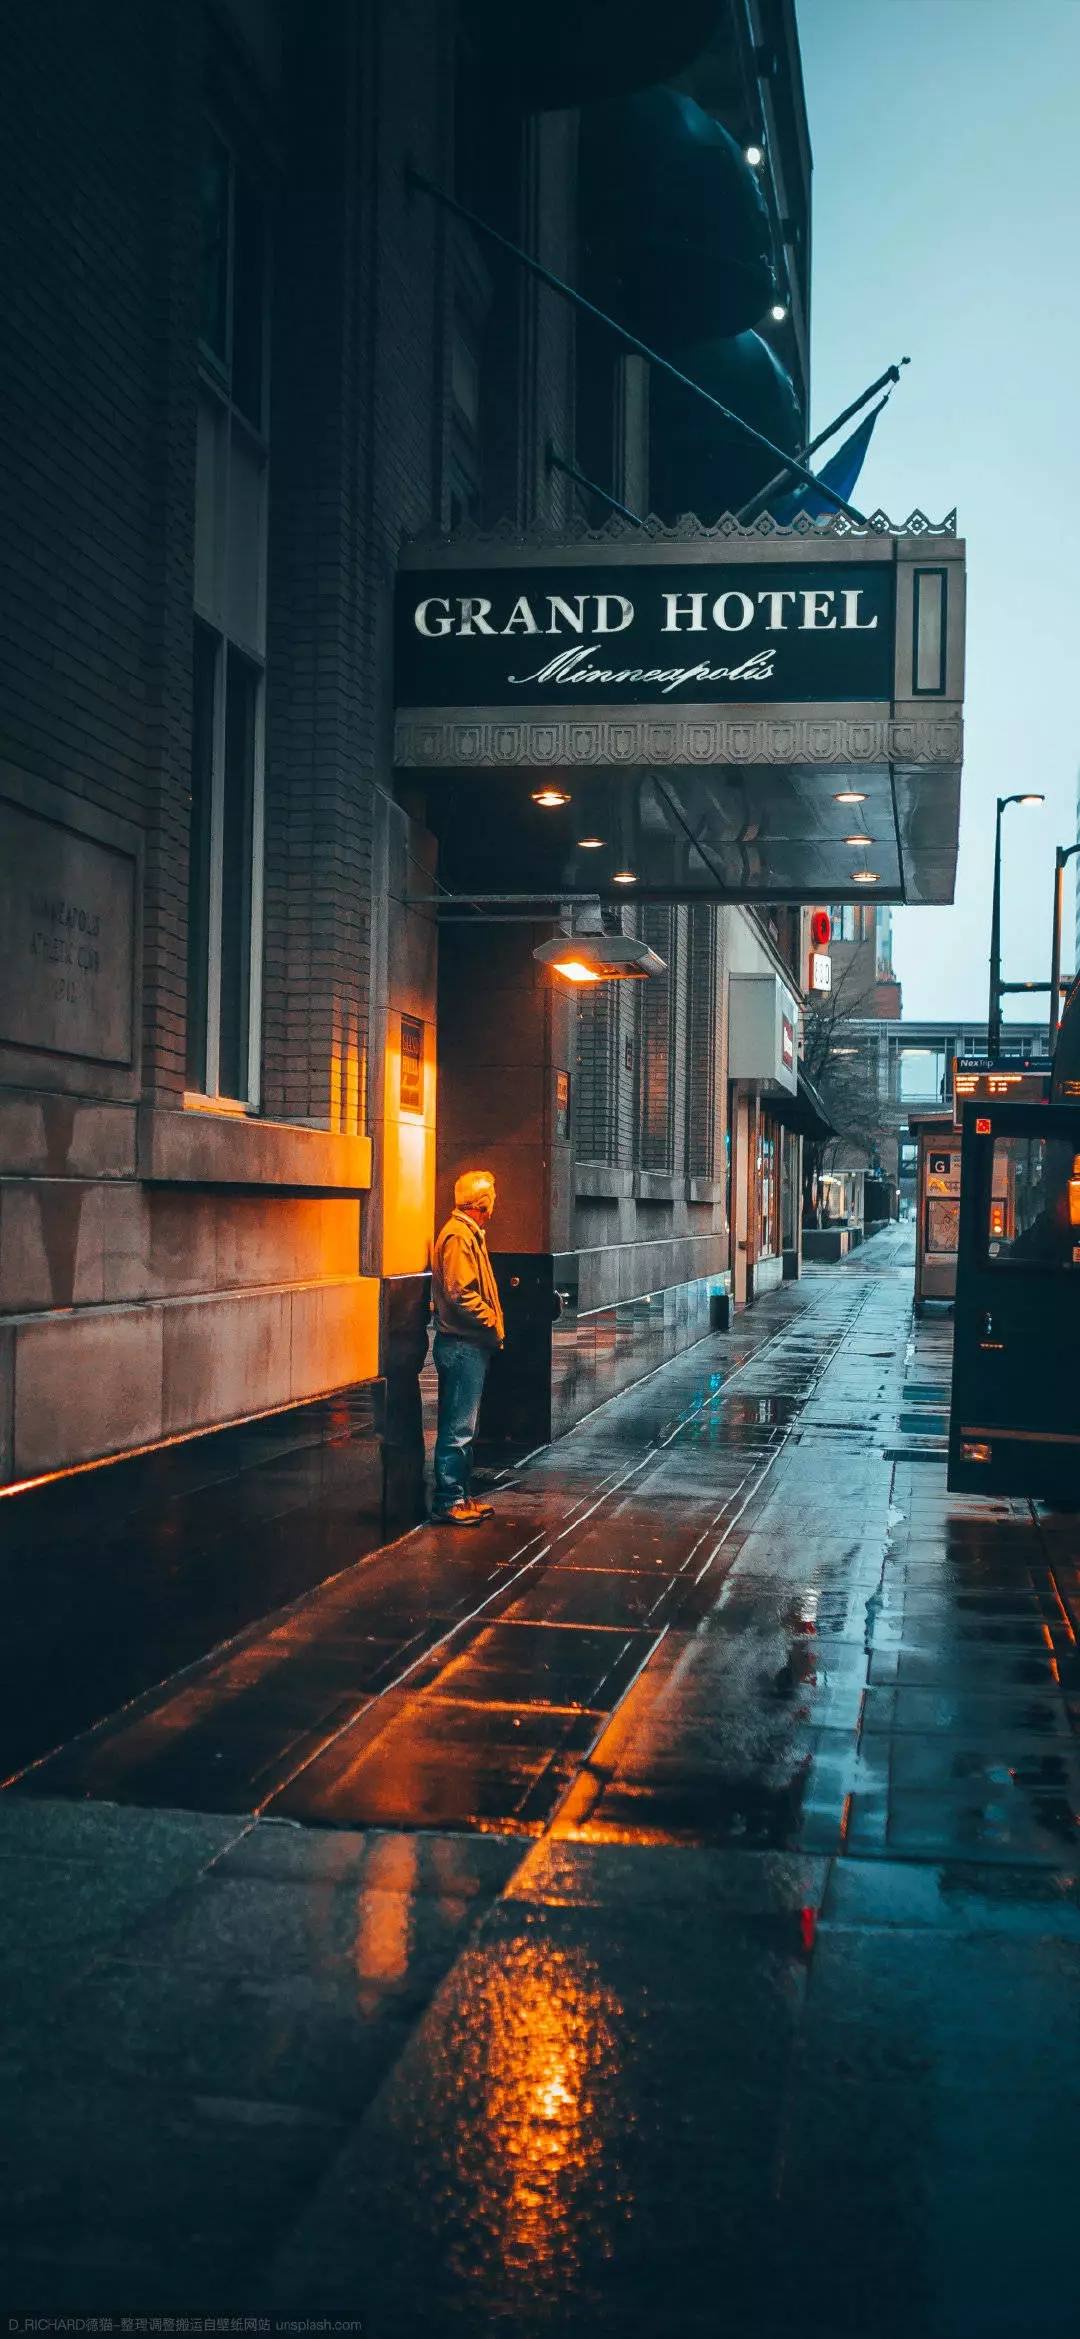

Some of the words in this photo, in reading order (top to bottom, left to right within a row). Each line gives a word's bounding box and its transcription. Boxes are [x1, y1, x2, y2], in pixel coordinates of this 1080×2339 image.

[414, 595, 635, 637] GRAND
[661, 590, 878, 632] HOTEL
[507, 644, 777, 694] Minneapolis
[960, 1059, 994, 1069] NexTrip
[935, 1160, 946, 1173] G
